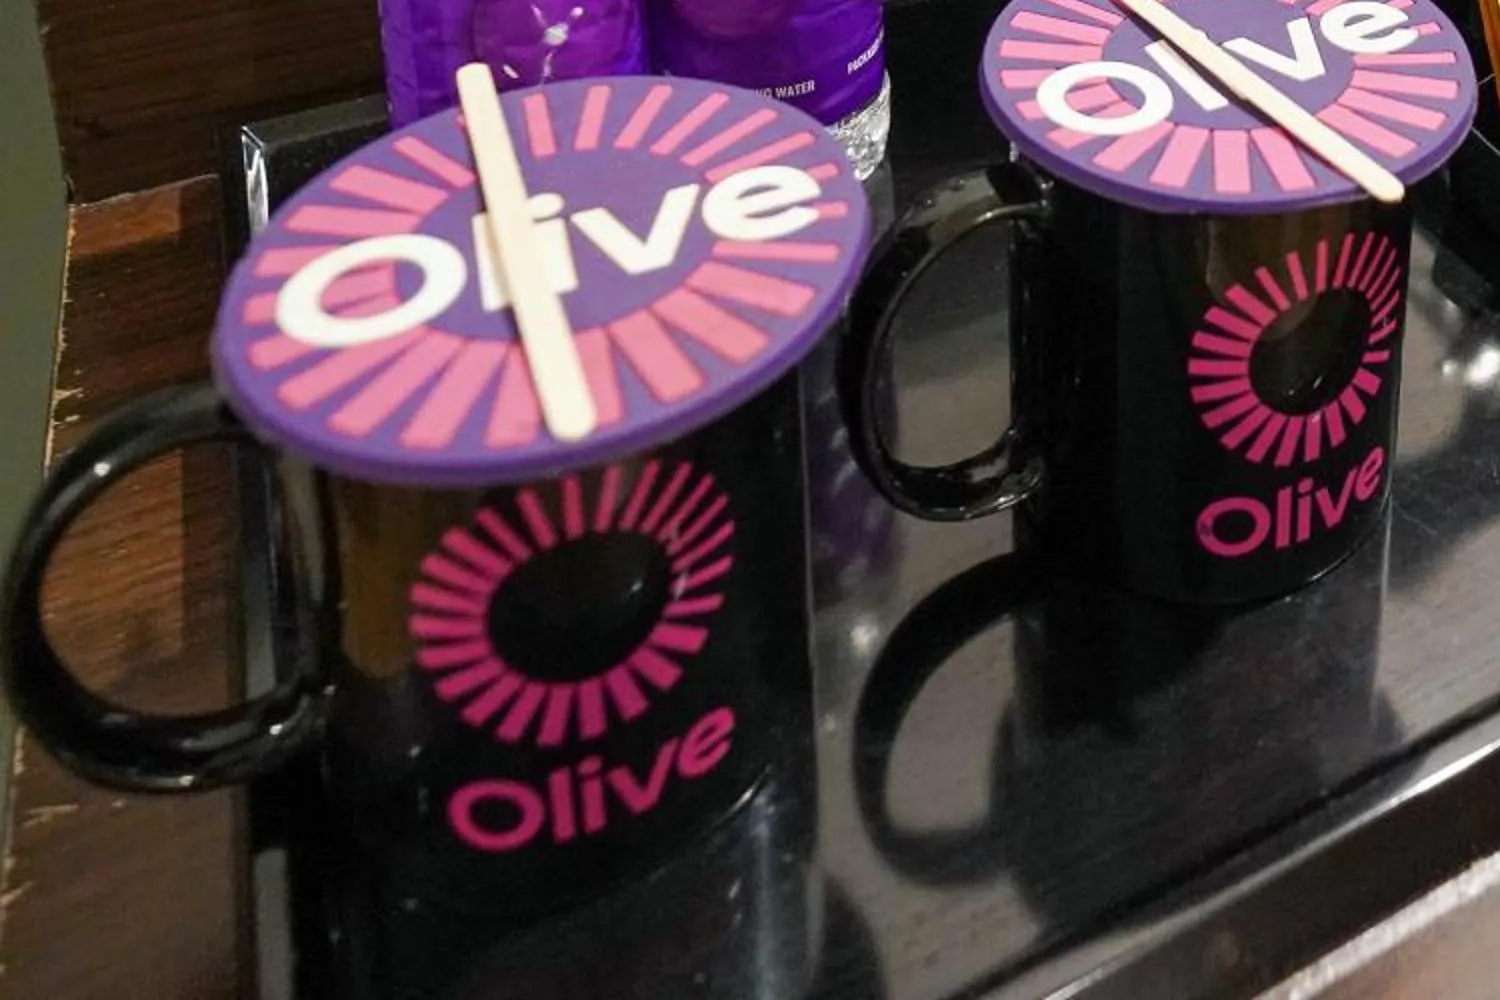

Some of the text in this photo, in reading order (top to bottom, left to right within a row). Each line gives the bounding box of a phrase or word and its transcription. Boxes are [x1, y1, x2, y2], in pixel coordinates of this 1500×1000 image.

[775, 79, 815, 98] WATER
[1036, 1, 1420, 136] Olve
[1196, 447, 1385, 558] Olive
[447, 706, 736, 851] Olive
